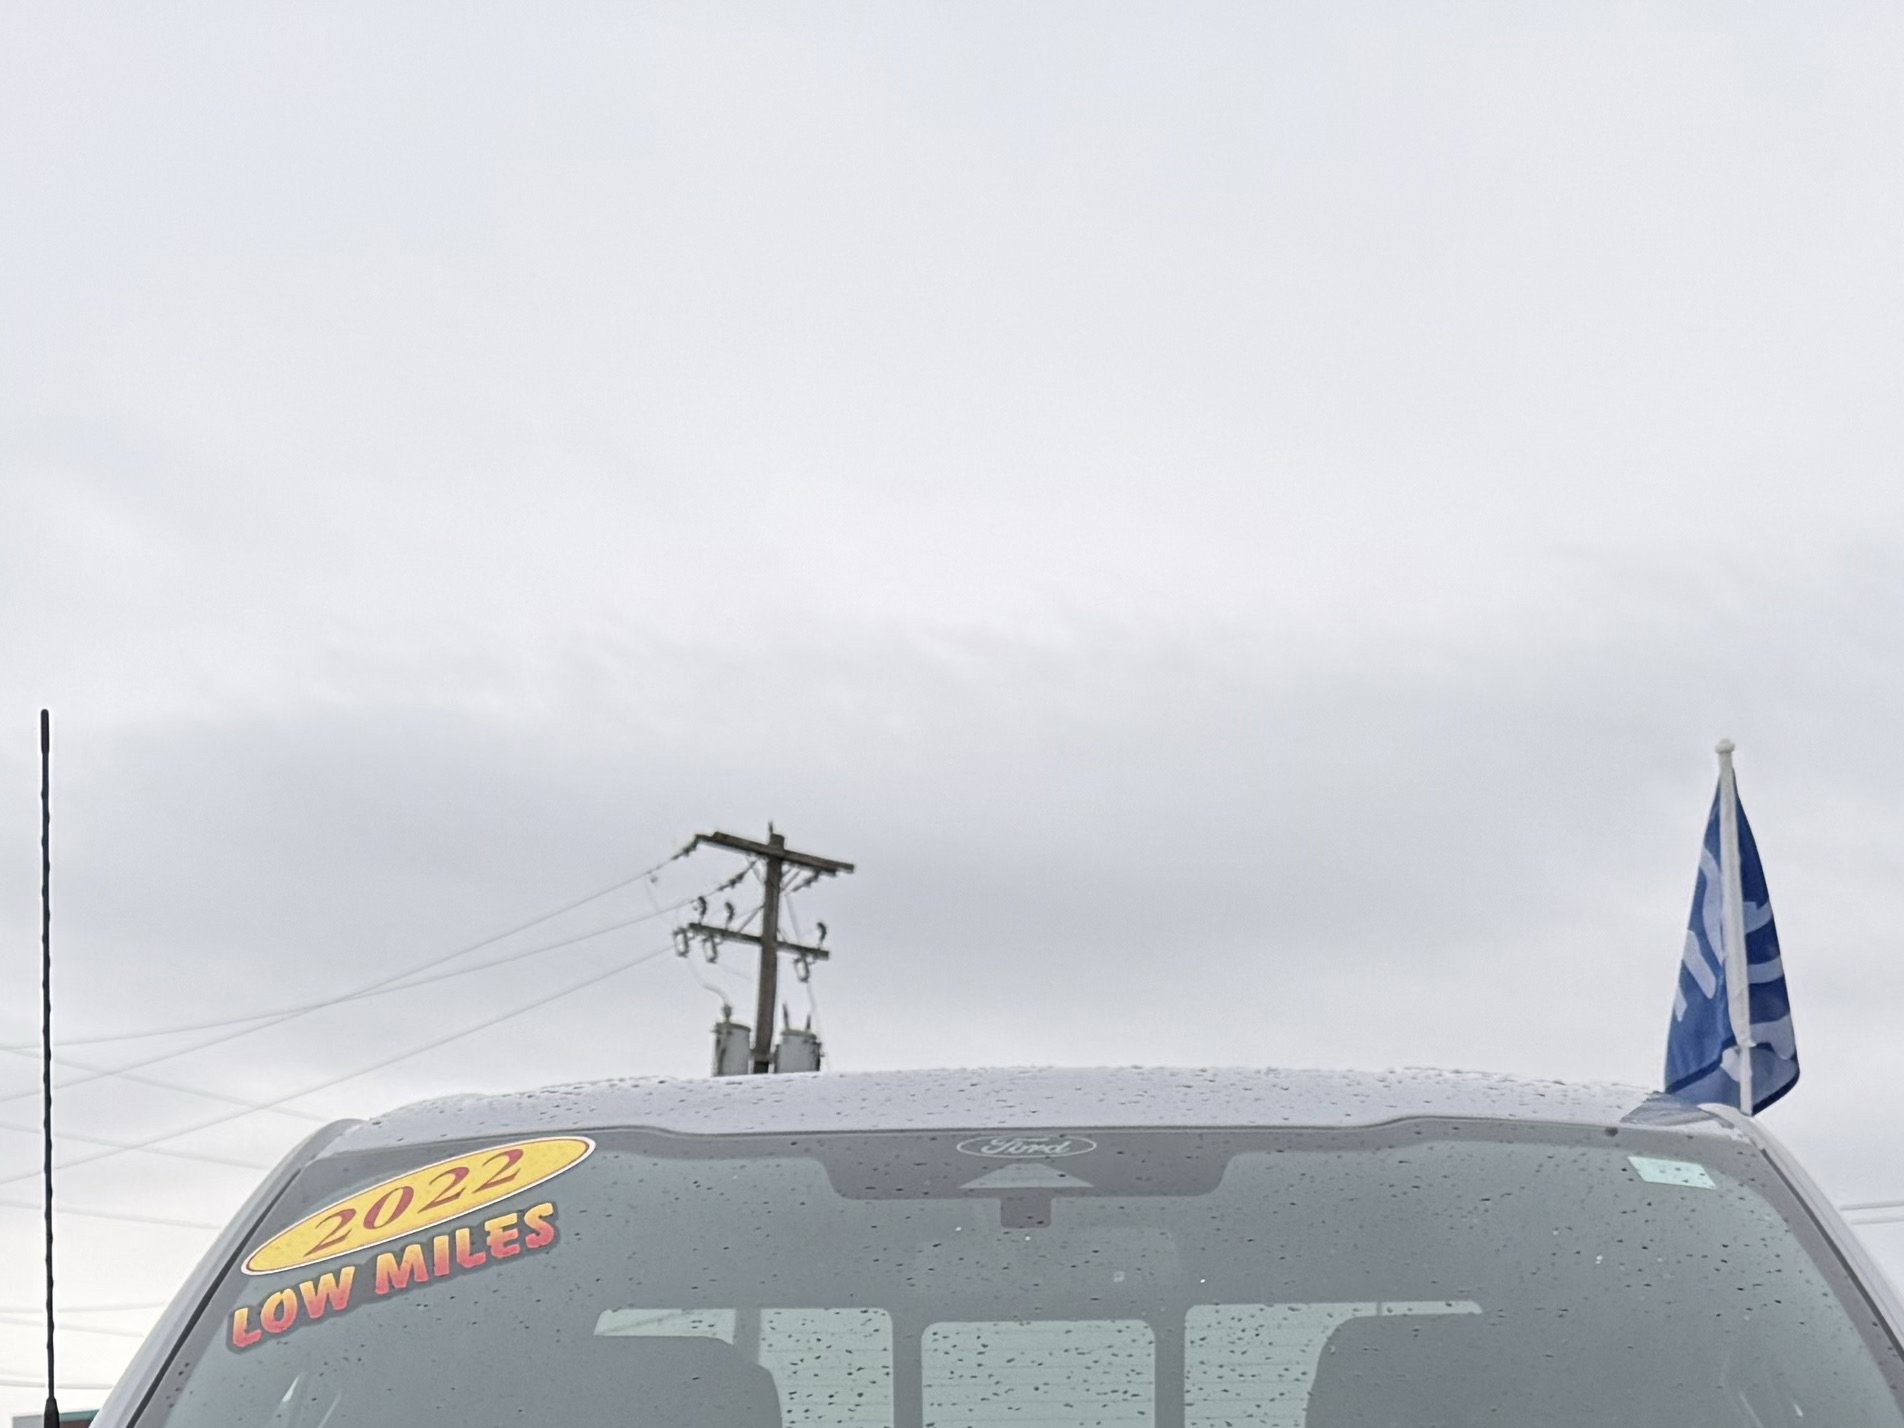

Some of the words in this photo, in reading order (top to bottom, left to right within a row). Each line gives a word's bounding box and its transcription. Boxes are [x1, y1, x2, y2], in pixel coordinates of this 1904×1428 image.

[980, 1137, 1072, 1154] Ford
[303, 1149, 524, 1257] 2022
[232, 1266, 356, 1348] LOW
[375, 1202, 556, 1295] MILES
